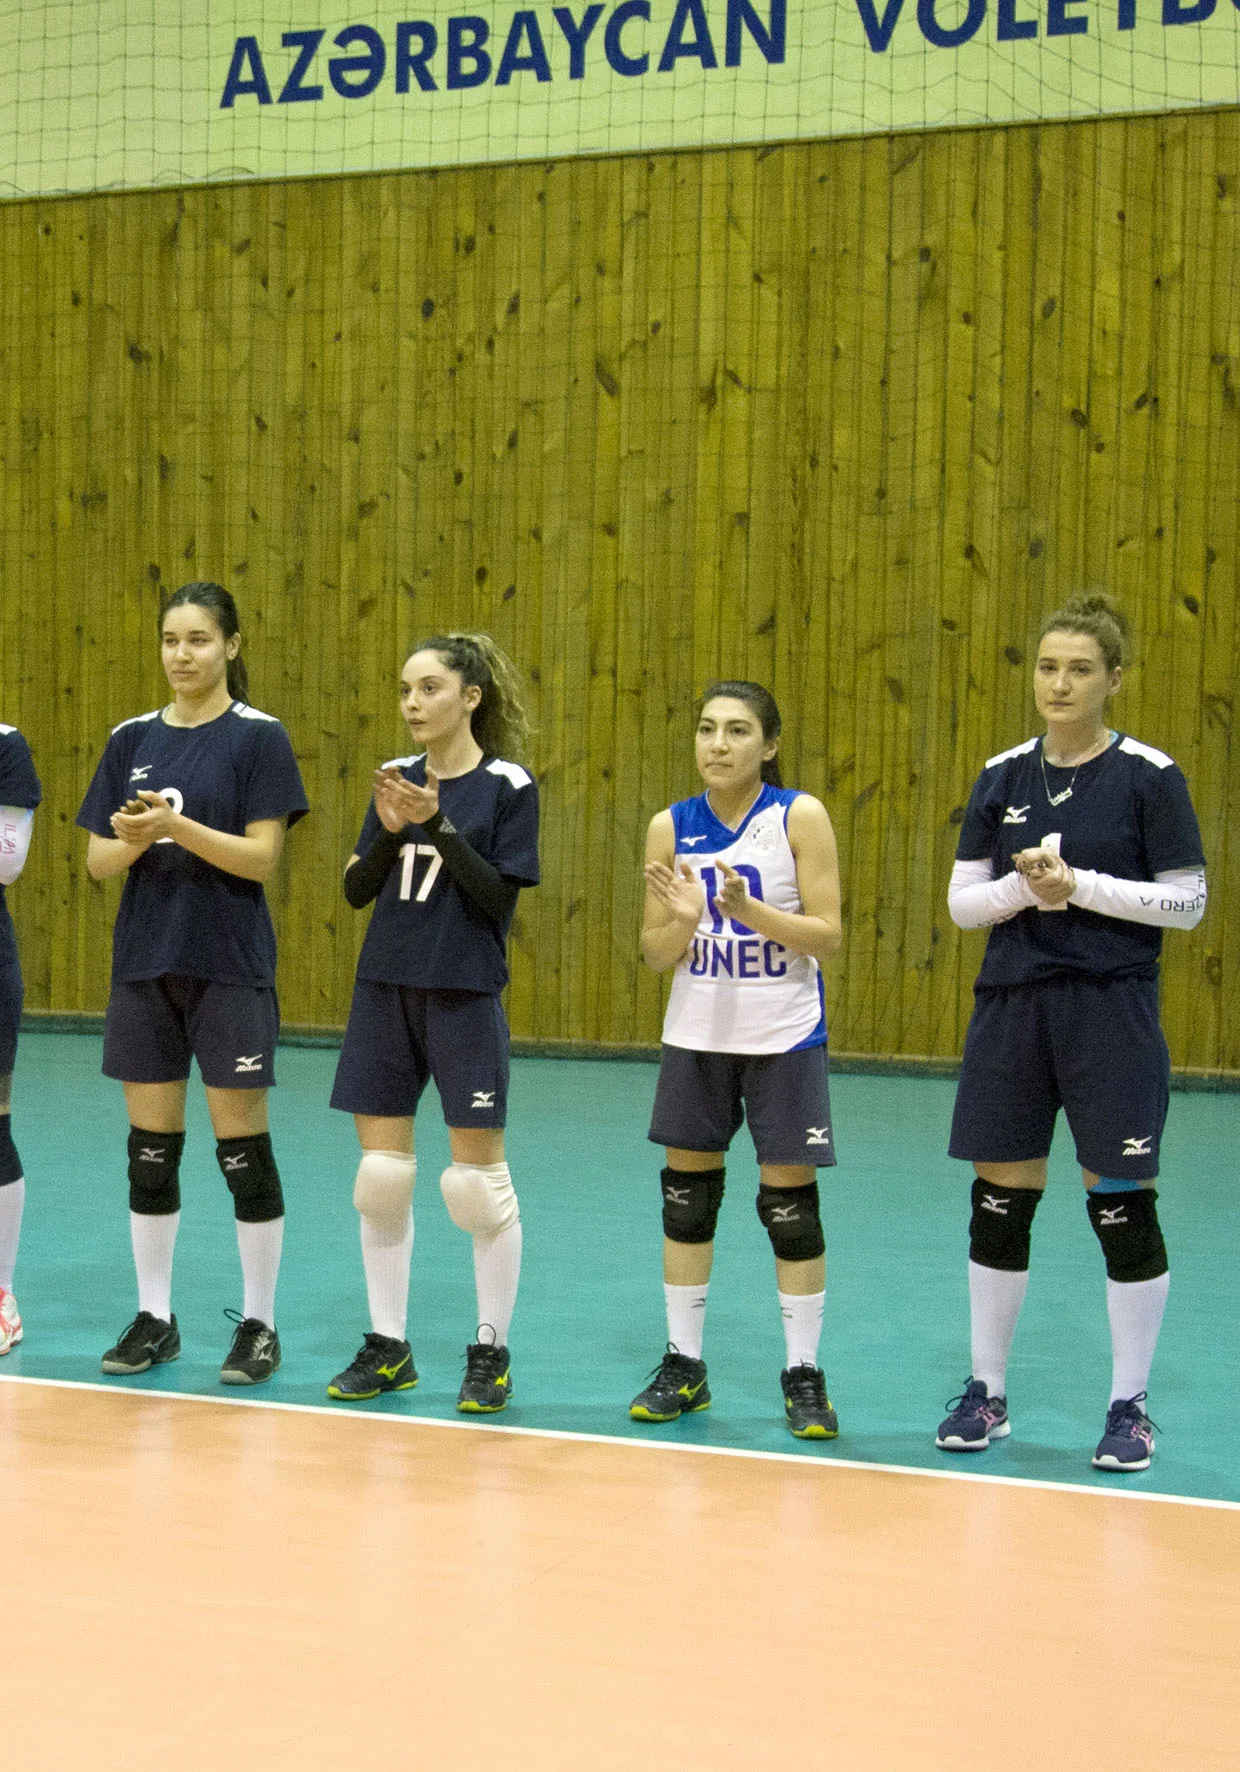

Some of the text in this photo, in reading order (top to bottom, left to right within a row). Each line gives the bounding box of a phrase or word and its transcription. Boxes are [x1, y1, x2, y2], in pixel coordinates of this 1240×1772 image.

[219, 0, 787, 108] AZƏRBAYCAN
[398, 843, 444, 902] 17
[700, 864, 764, 936] 10
[689, 938, 788, 979] UNEC
